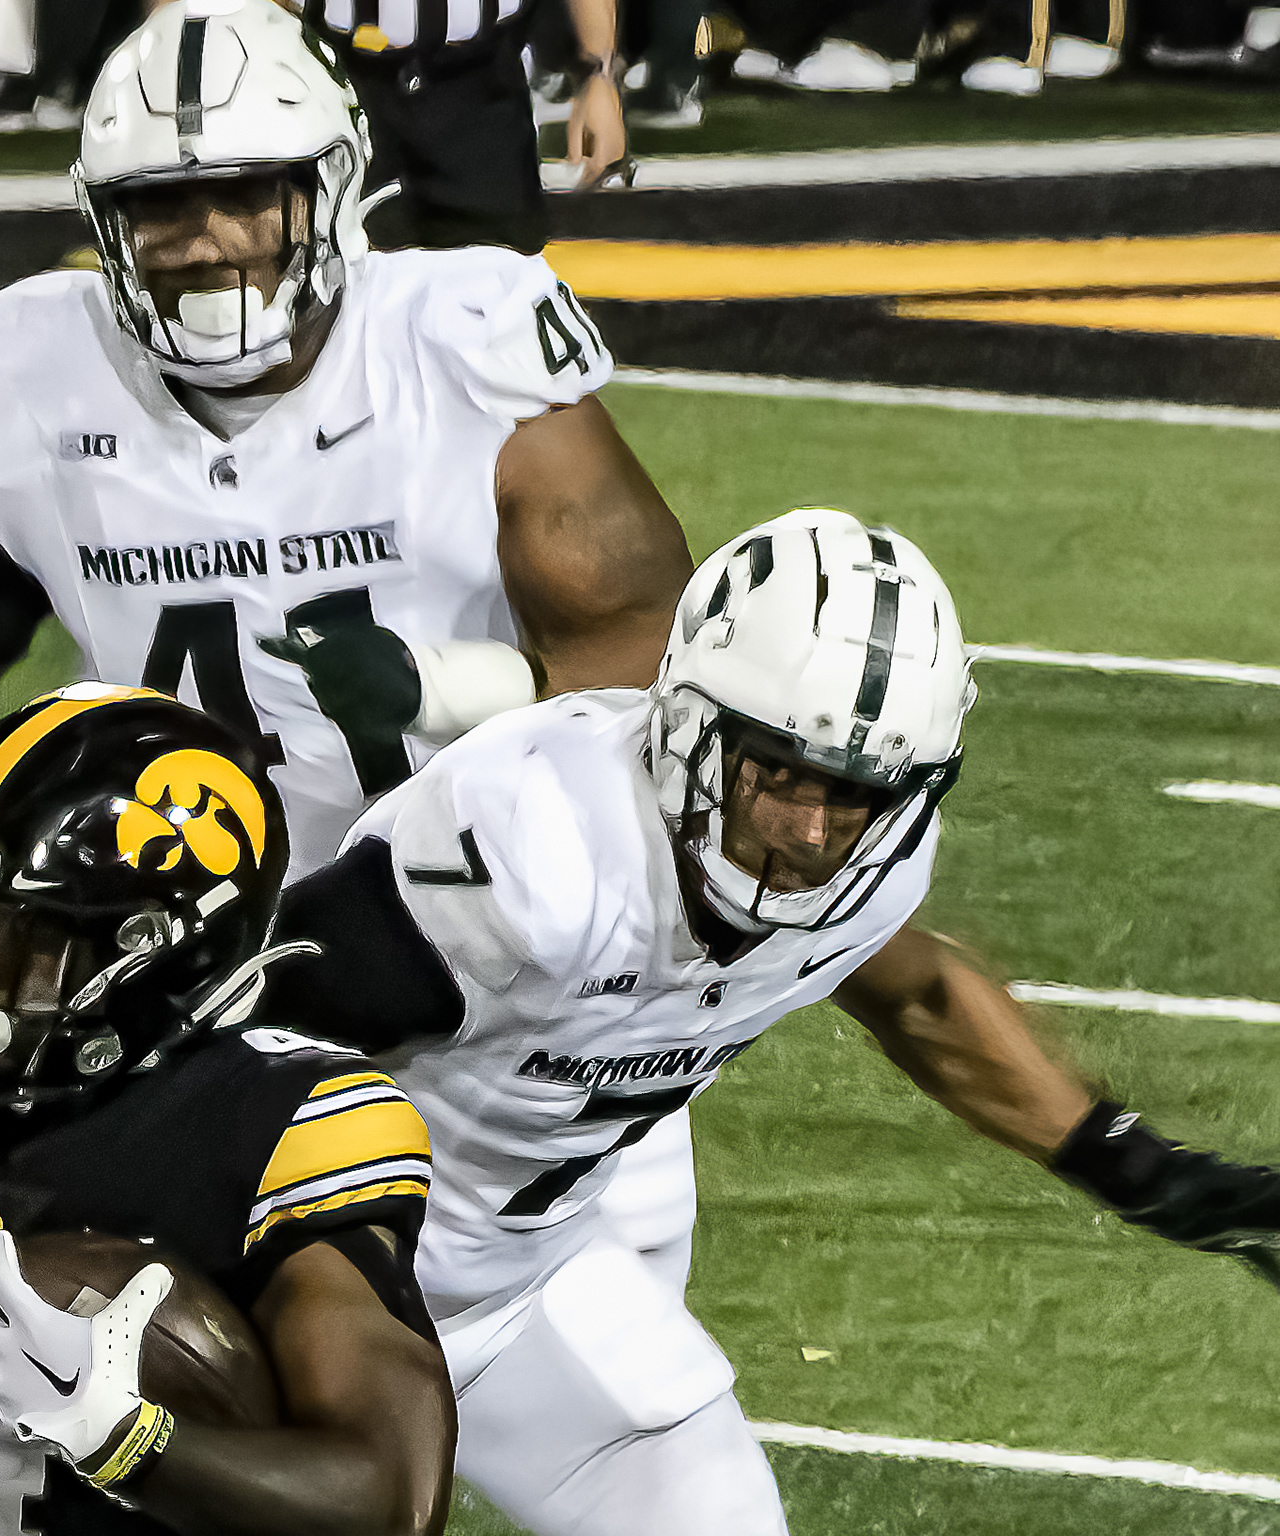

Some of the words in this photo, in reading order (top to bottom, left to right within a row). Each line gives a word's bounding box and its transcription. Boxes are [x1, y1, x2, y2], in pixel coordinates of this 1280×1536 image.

[77, 537, 269, 587] MICHIGAN
[402, 825, 494, 887] 7
[495, 1078, 704, 1217] 7
